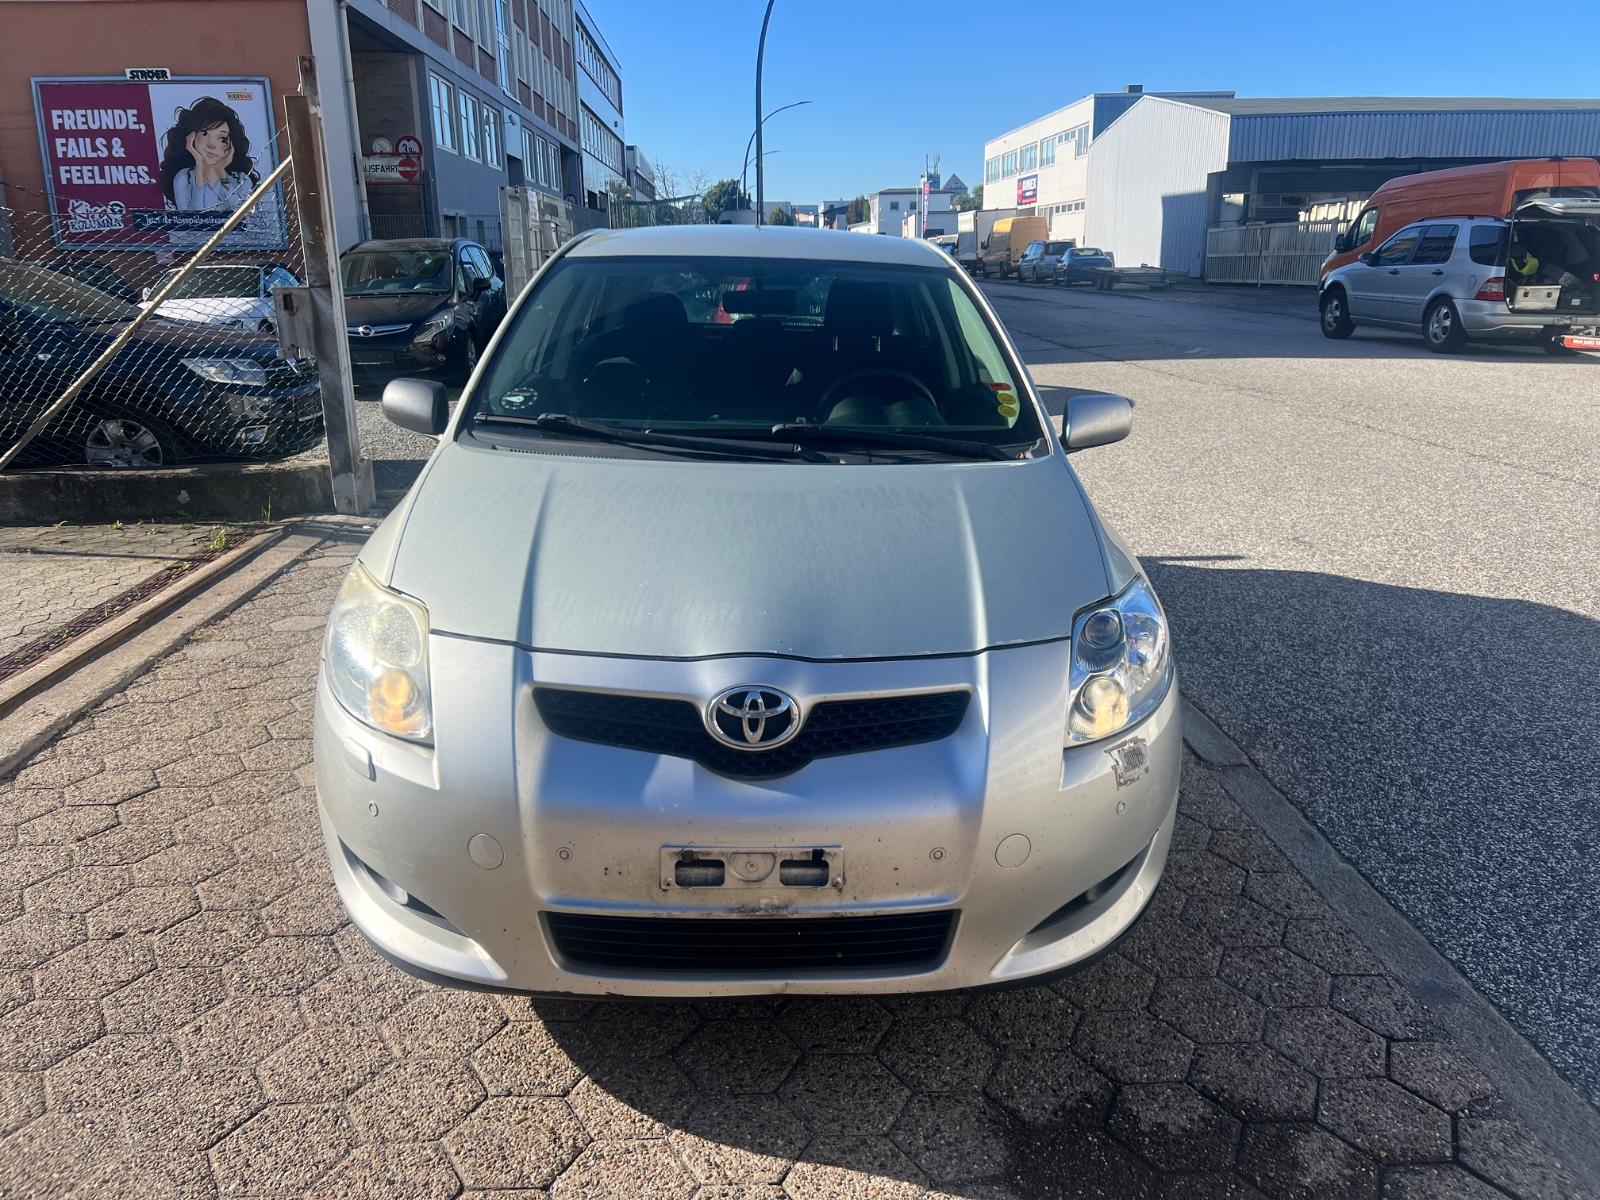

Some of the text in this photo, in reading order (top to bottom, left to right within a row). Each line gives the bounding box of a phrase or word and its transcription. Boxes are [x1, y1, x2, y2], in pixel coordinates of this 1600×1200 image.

[51, 109, 146, 133] FREUNDE,
[55, 137, 127, 158] FAILS &
[60, 165, 157, 185] FEELINGS.
